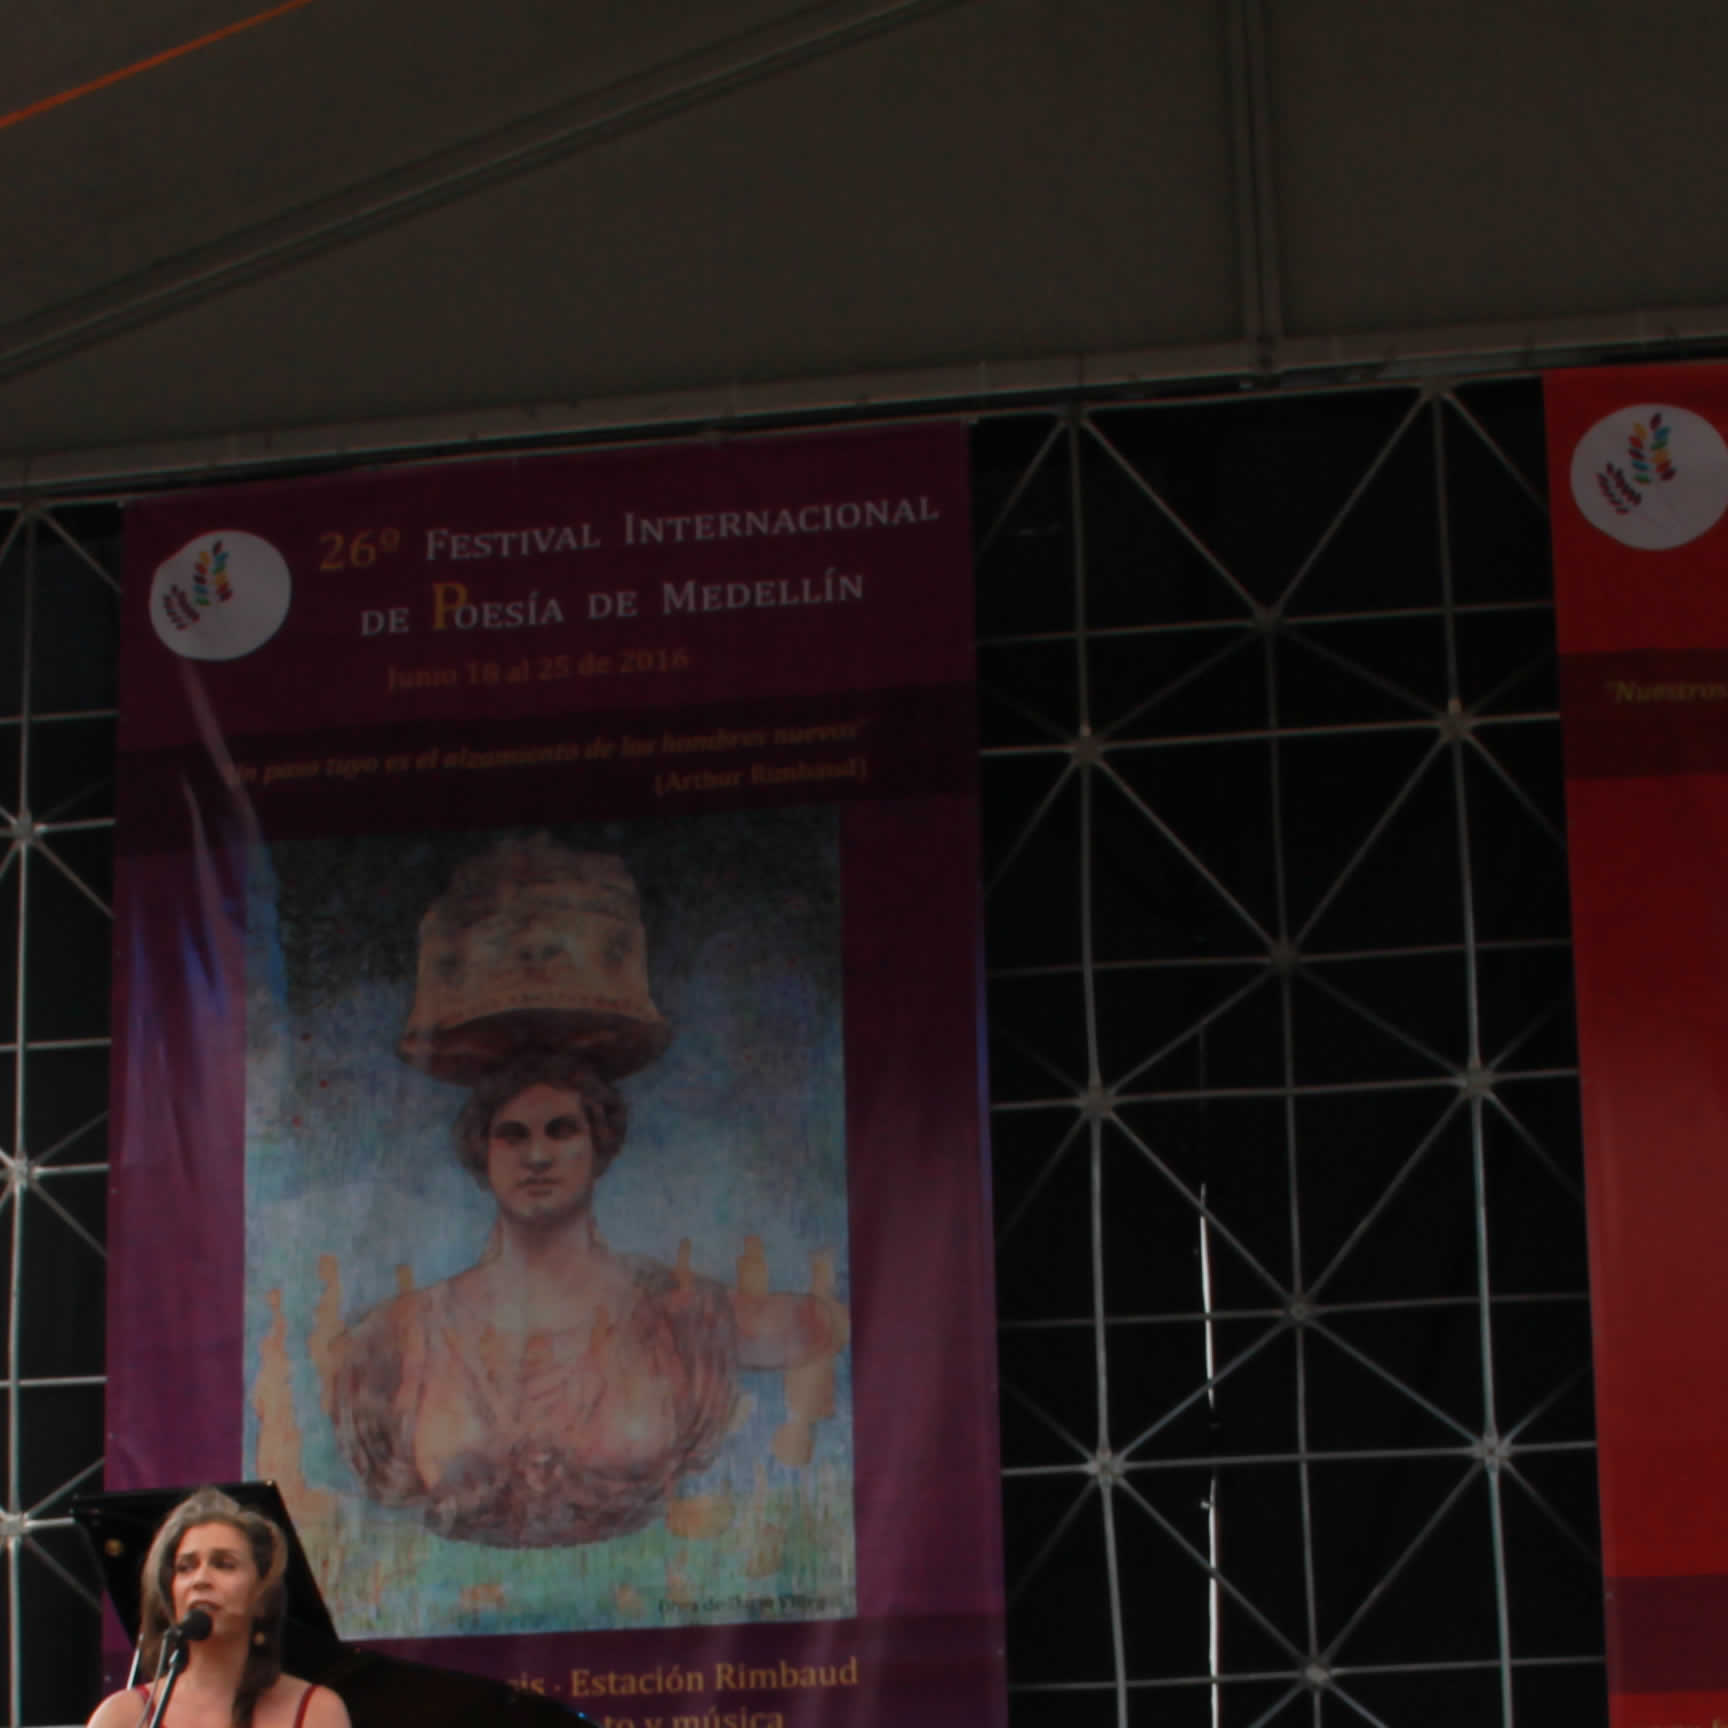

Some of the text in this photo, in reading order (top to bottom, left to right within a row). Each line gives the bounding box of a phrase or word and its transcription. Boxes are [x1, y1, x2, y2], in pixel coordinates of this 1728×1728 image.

[318, 493, 939, 574] 26º FESTIVAL INTERNACIONAL
[359, 566, 865, 640] DE POESÍA DE MEDELLÍN
[387, 663, 458, 695] Junio
[505, 658, 531, 683] al
[535, 655, 570, 682] 25
[580, 651, 614, 679] de
[569, 1664, 706, 1698] Estación
[715, 1655, 860, 1692] Rimbaud
